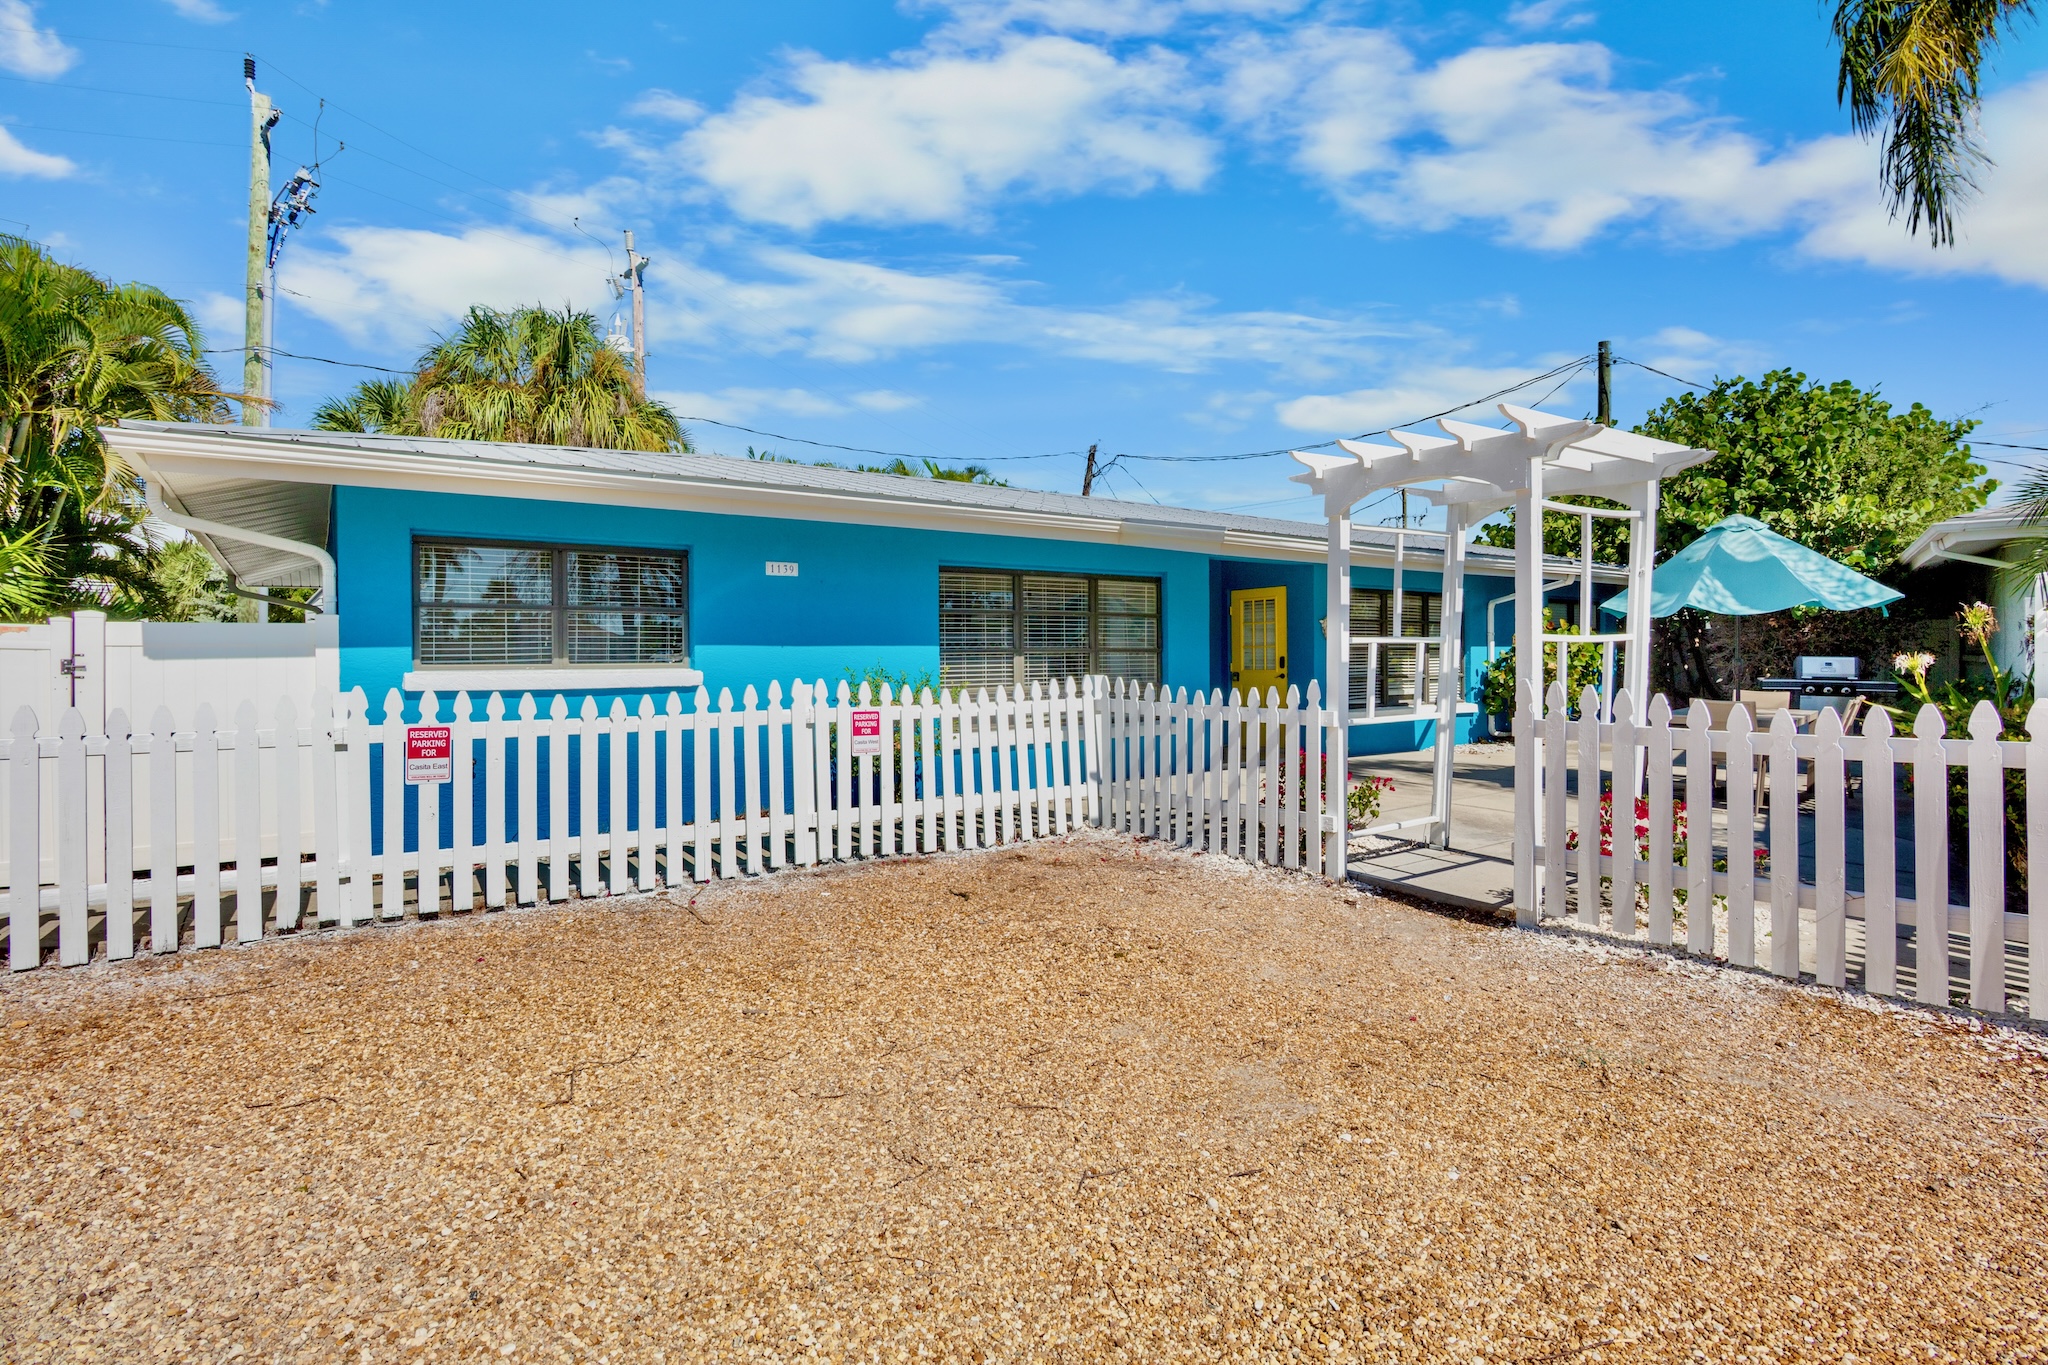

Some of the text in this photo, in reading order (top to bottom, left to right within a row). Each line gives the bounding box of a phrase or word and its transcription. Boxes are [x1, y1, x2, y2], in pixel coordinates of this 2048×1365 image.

[771, 564, 794, 573] 1139
[410, 730, 449, 739] RESERVED
[411, 739, 447, 748] PARKING
[421, 749, 437, 757] FOR
[409, 763, 431, 771] Casita
